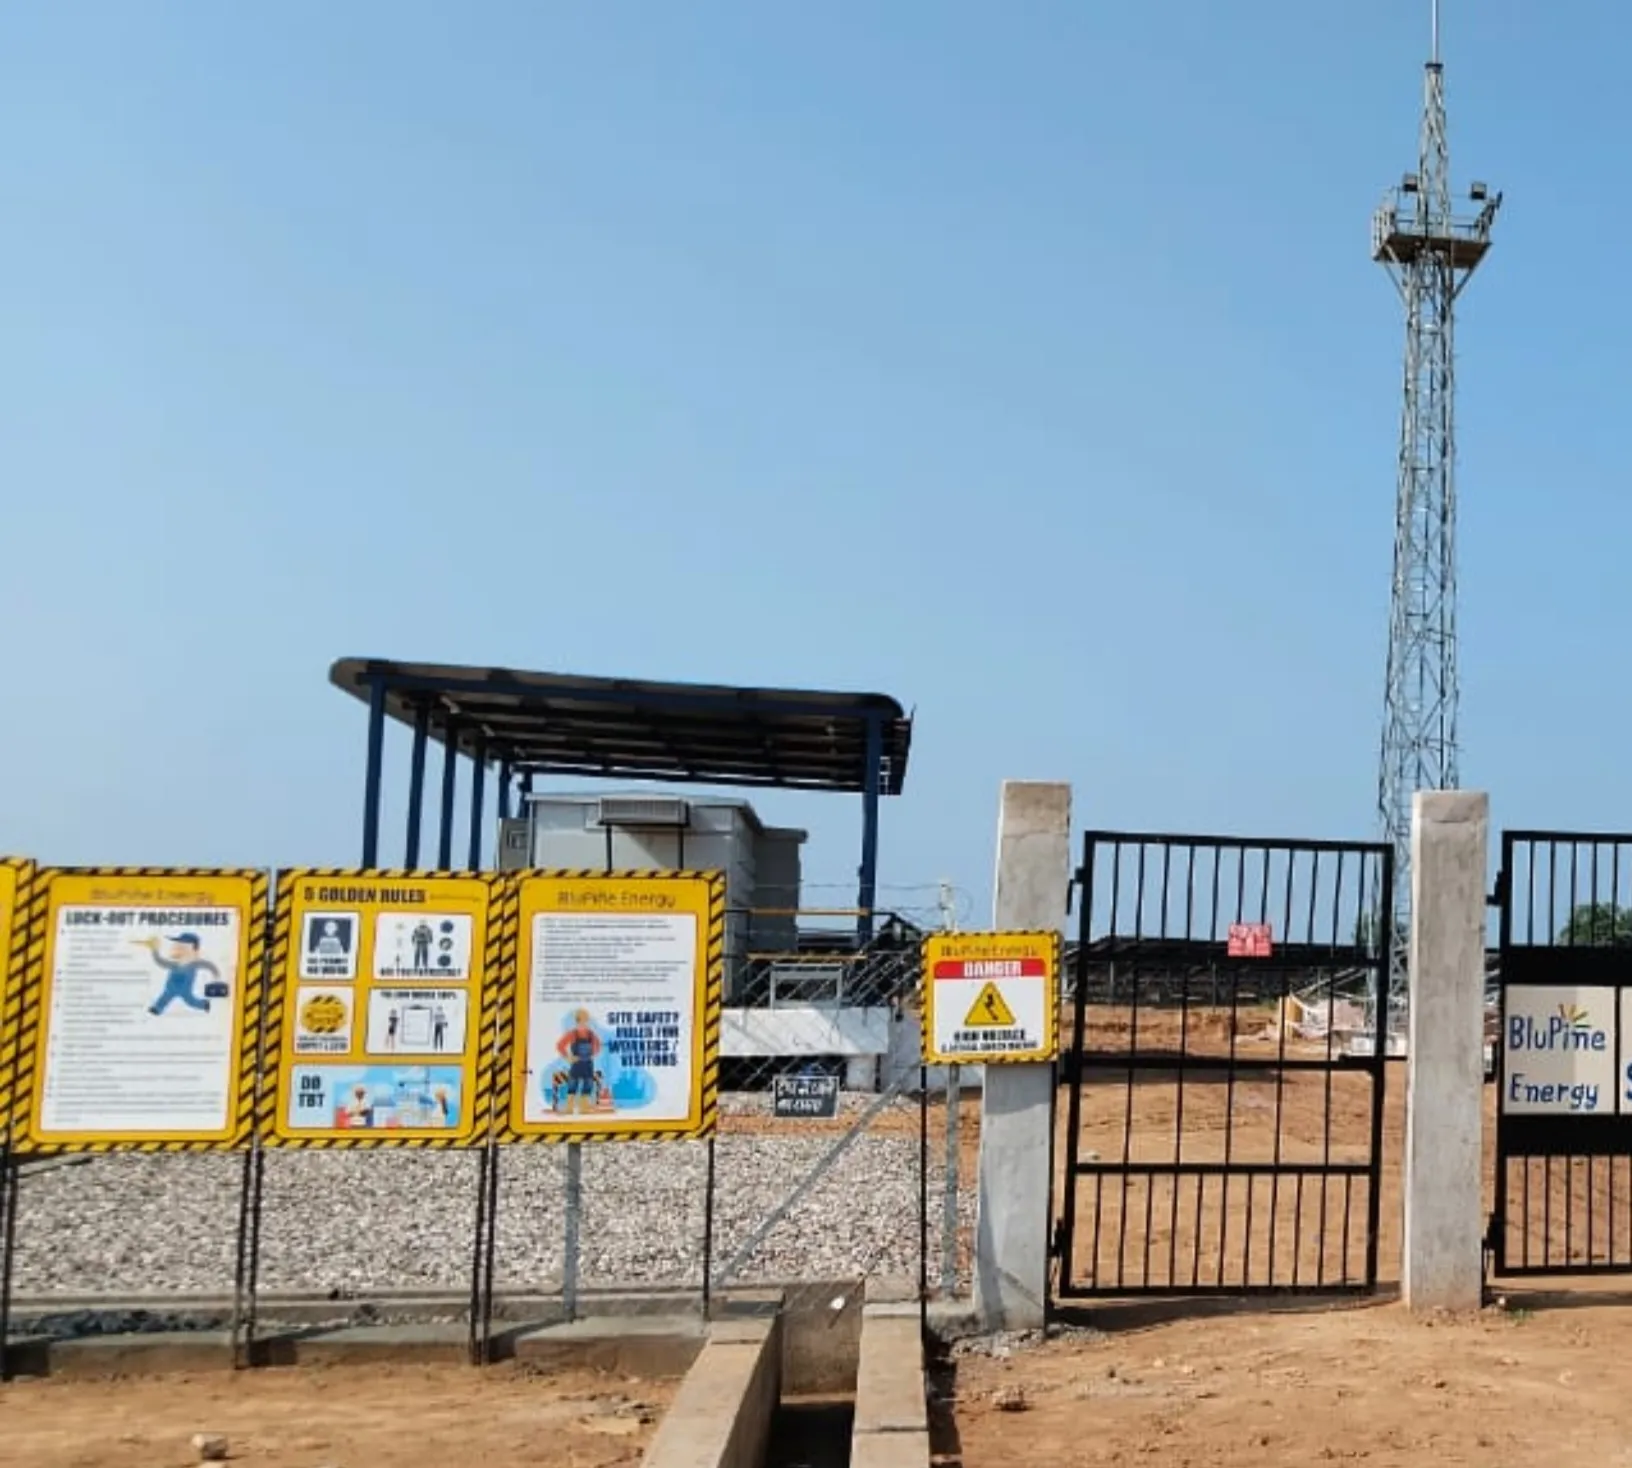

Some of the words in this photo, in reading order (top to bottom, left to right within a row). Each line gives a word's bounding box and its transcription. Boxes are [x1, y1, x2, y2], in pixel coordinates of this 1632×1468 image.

[319, 887, 376, 902] GOLDEN
[380, 888, 425, 903] RULES
[66, 911, 135, 925] LOCK-OUT
[138, 911, 229, 926] PROCEDURES
[963, 960, 1023, 977] DANGER
[608, 1011, 633, 1025] SITE
[636, 1011, 679, 1024] SAFETY
[1508, 1013, 1607, 1052] BluPine
[608, 1039, 669, 1053] WORKERS
[621, 1053, 677, 1067] VISITORS
[301, 1075, 321, 1090] DO
[1508, 1073, 1600, 1110] Energy
[298, 1093, 324, 1107] TBT
